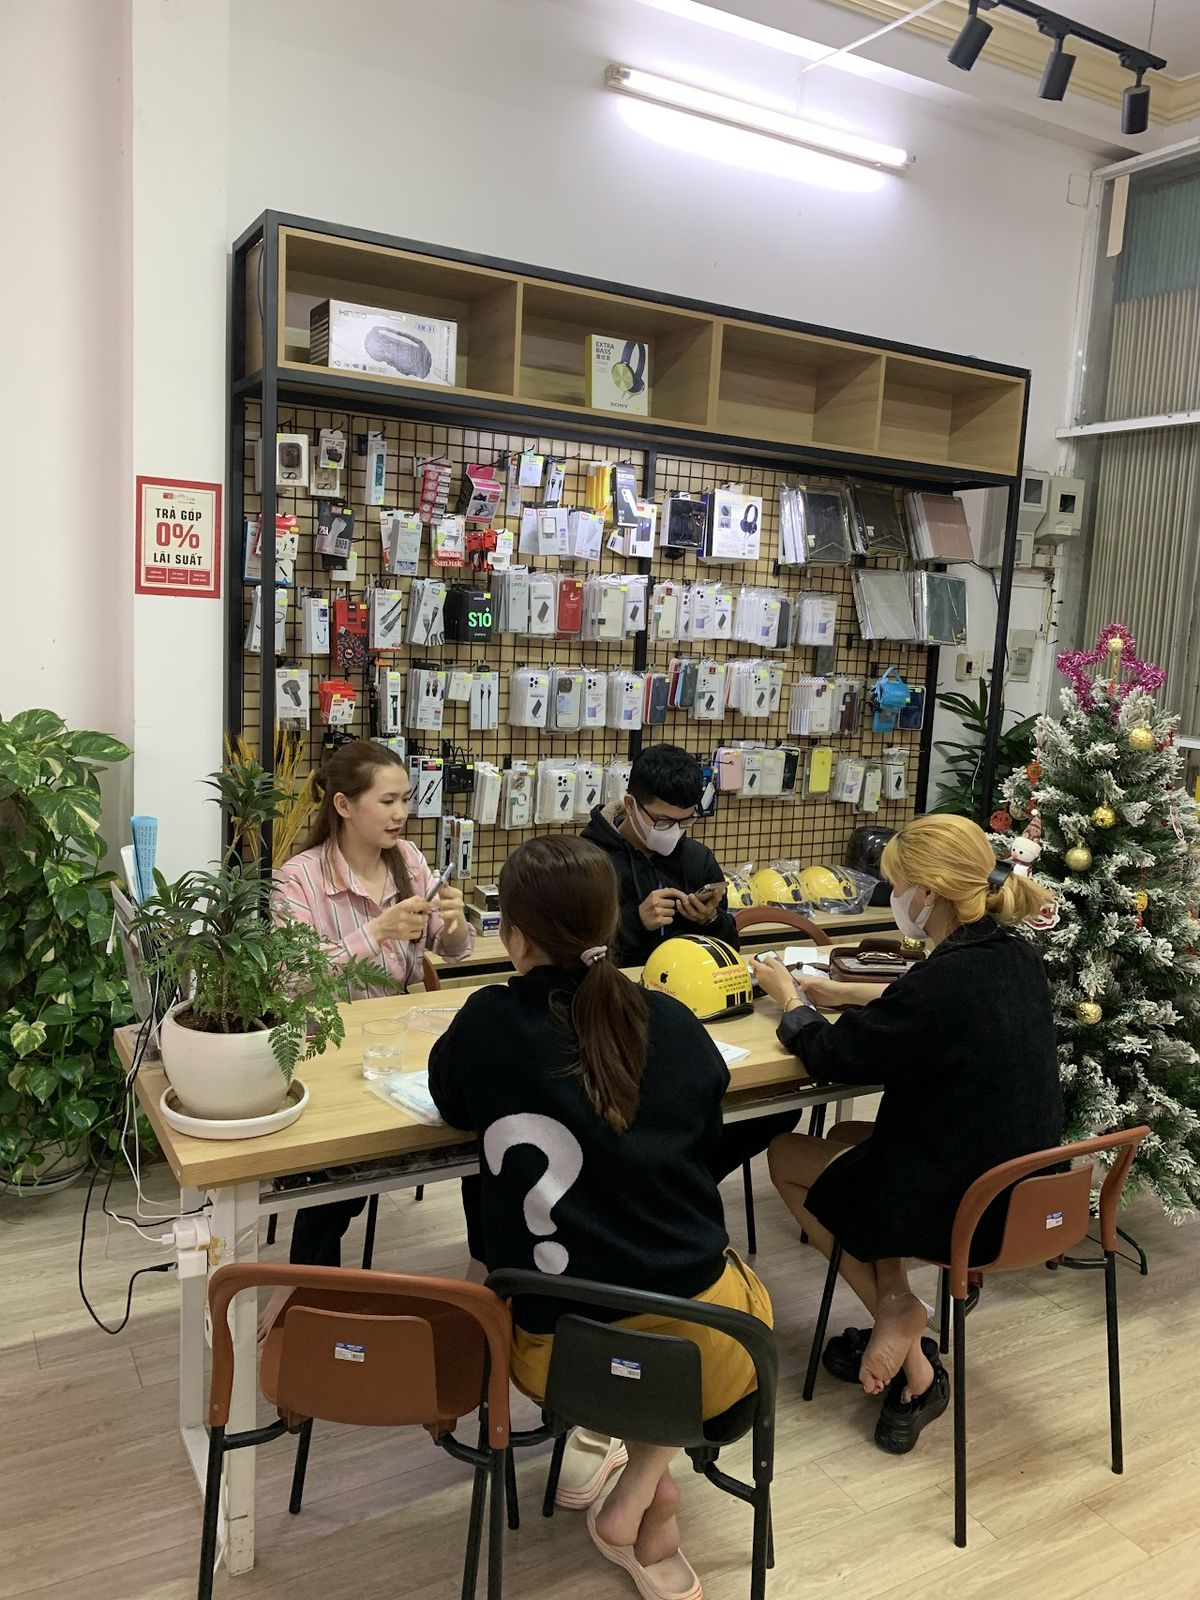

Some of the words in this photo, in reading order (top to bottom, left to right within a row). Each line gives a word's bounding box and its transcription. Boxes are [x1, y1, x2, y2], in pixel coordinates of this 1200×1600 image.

[596, 347, 611, 355] BASS
[156, 506, 175, 519] TRẢ
[181, 508, 202, 521] GÓP
[156, 522, 200, 549] 0%
[154, 551, 170, 563] LÃI
[175, 553, 202, 565] SUẤT
[434, 559, 462, 567] SanDisk
[484, 1112, 584, 1275] ?
